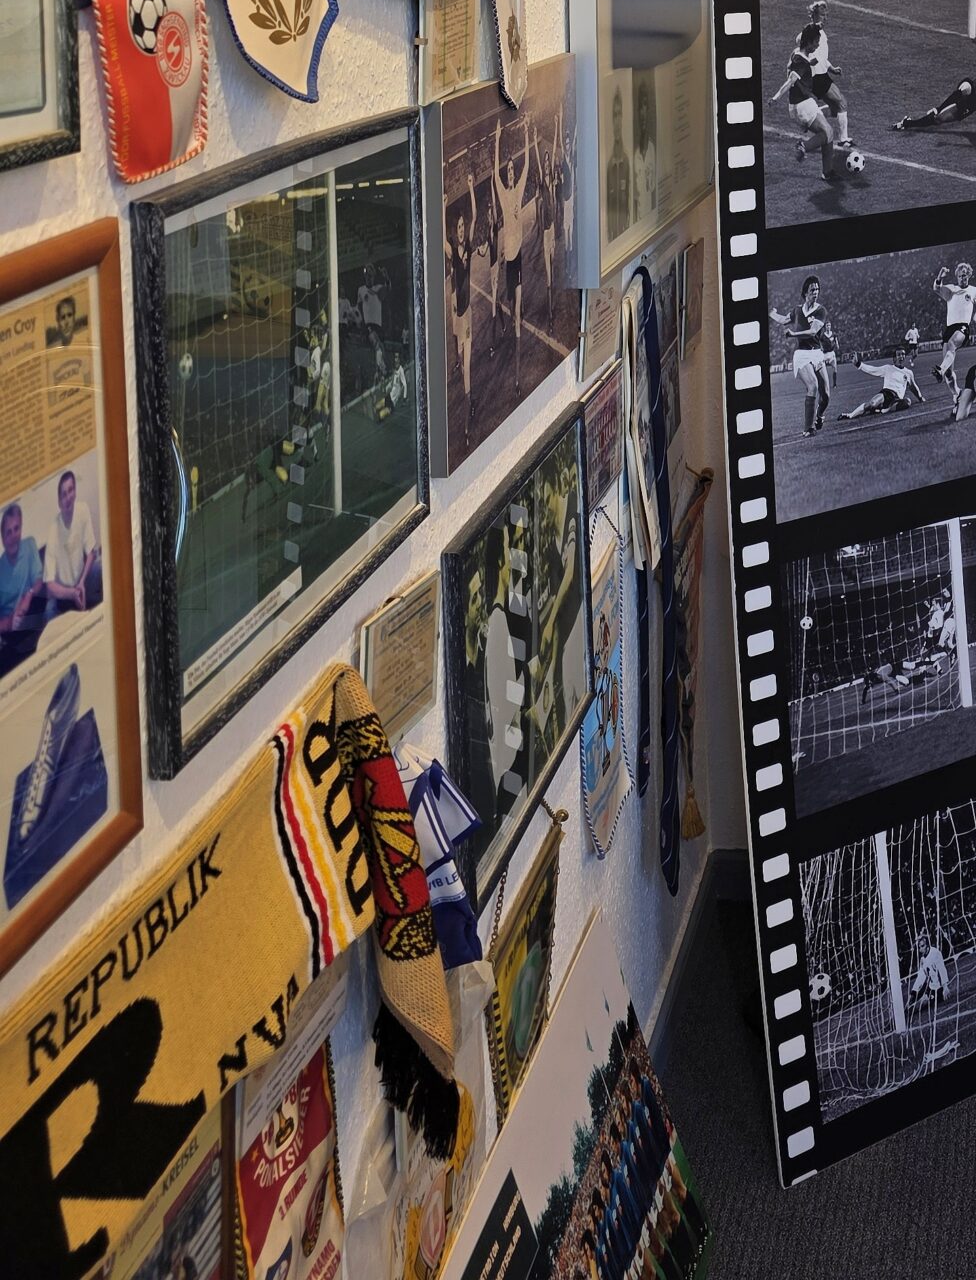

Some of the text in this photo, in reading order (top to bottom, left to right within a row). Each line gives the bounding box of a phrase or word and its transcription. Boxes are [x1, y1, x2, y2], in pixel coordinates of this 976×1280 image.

[14, 316, 37, 336] Croy
[25, 831, 224, 1085] REPUBLIK
[217, 972, 301, 1093] NVA
